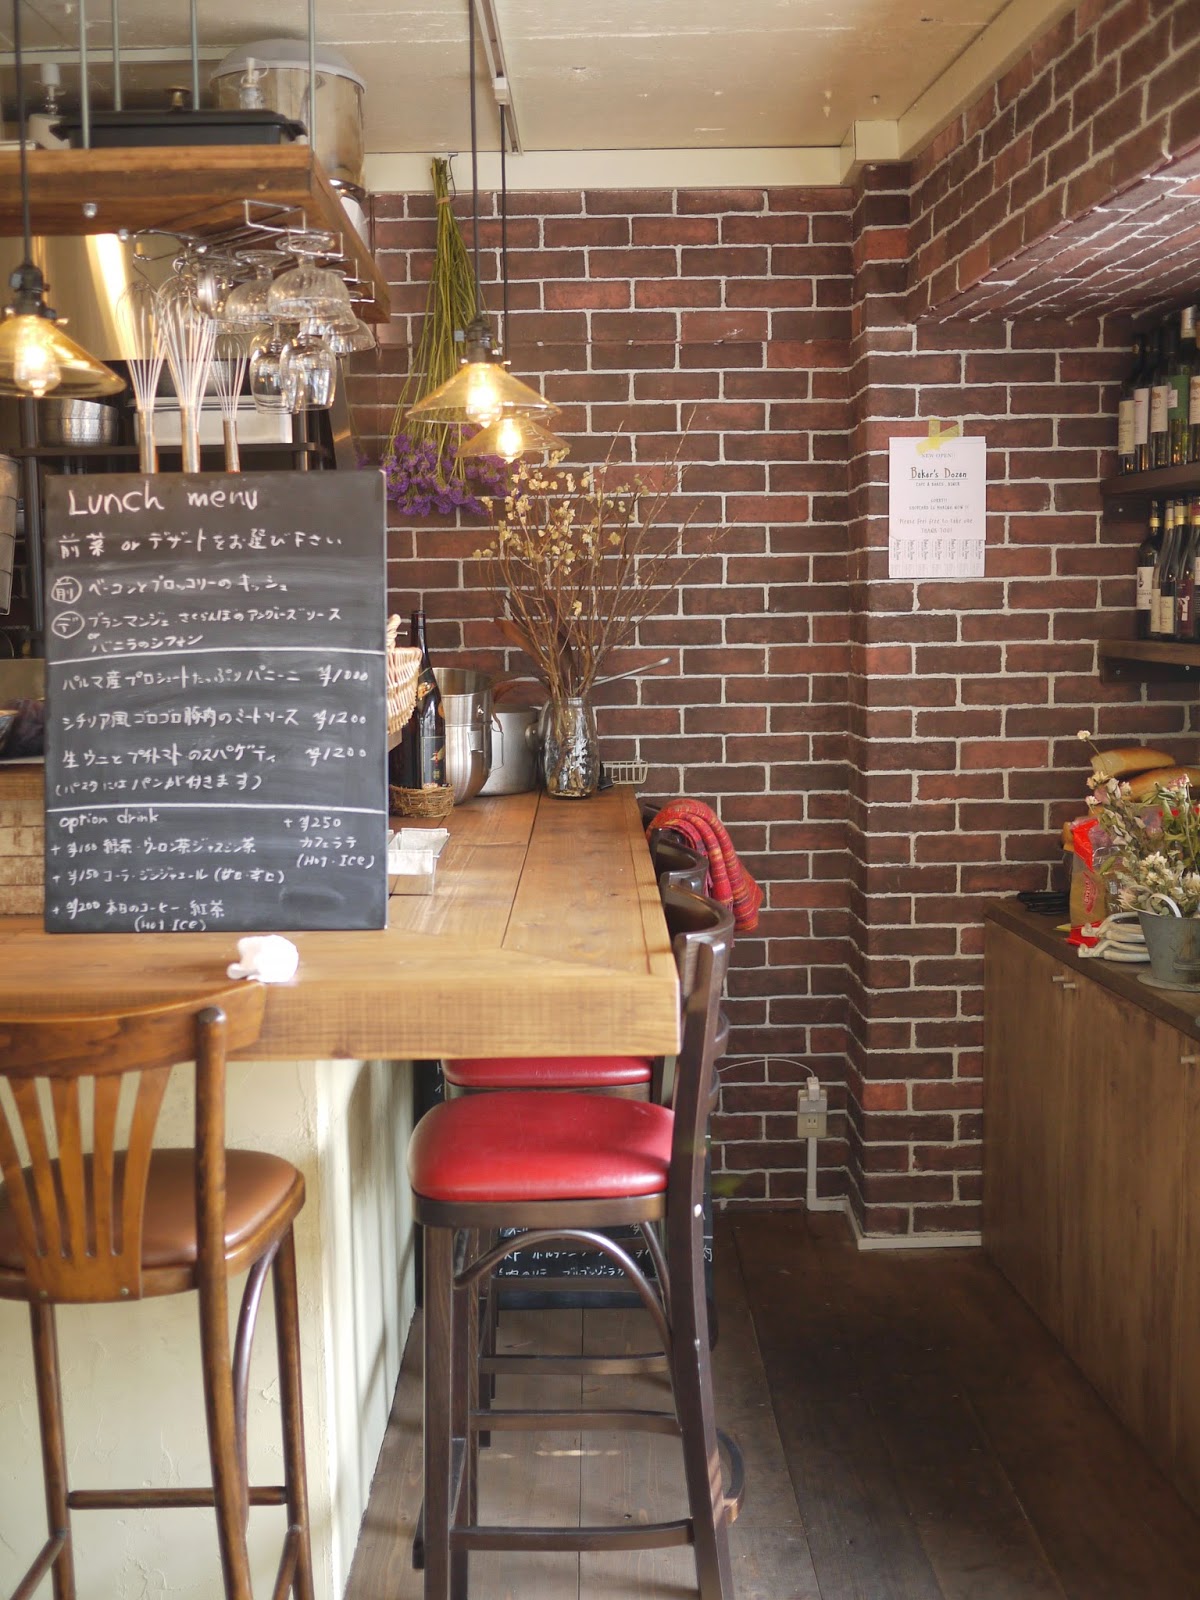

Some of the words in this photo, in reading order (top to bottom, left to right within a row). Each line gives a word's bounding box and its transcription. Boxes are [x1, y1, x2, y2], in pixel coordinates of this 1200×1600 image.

[944, 467, 967, 479] Dozen
[68, 480, 165, 516] Lunch
[187, 490, 258, 510] menu
[121, 540, 141, 551] or
[59, 813, 109, 834] option
[117, 808, 160, 824] drink
[299, 836, 357, 849] カフェラテ
